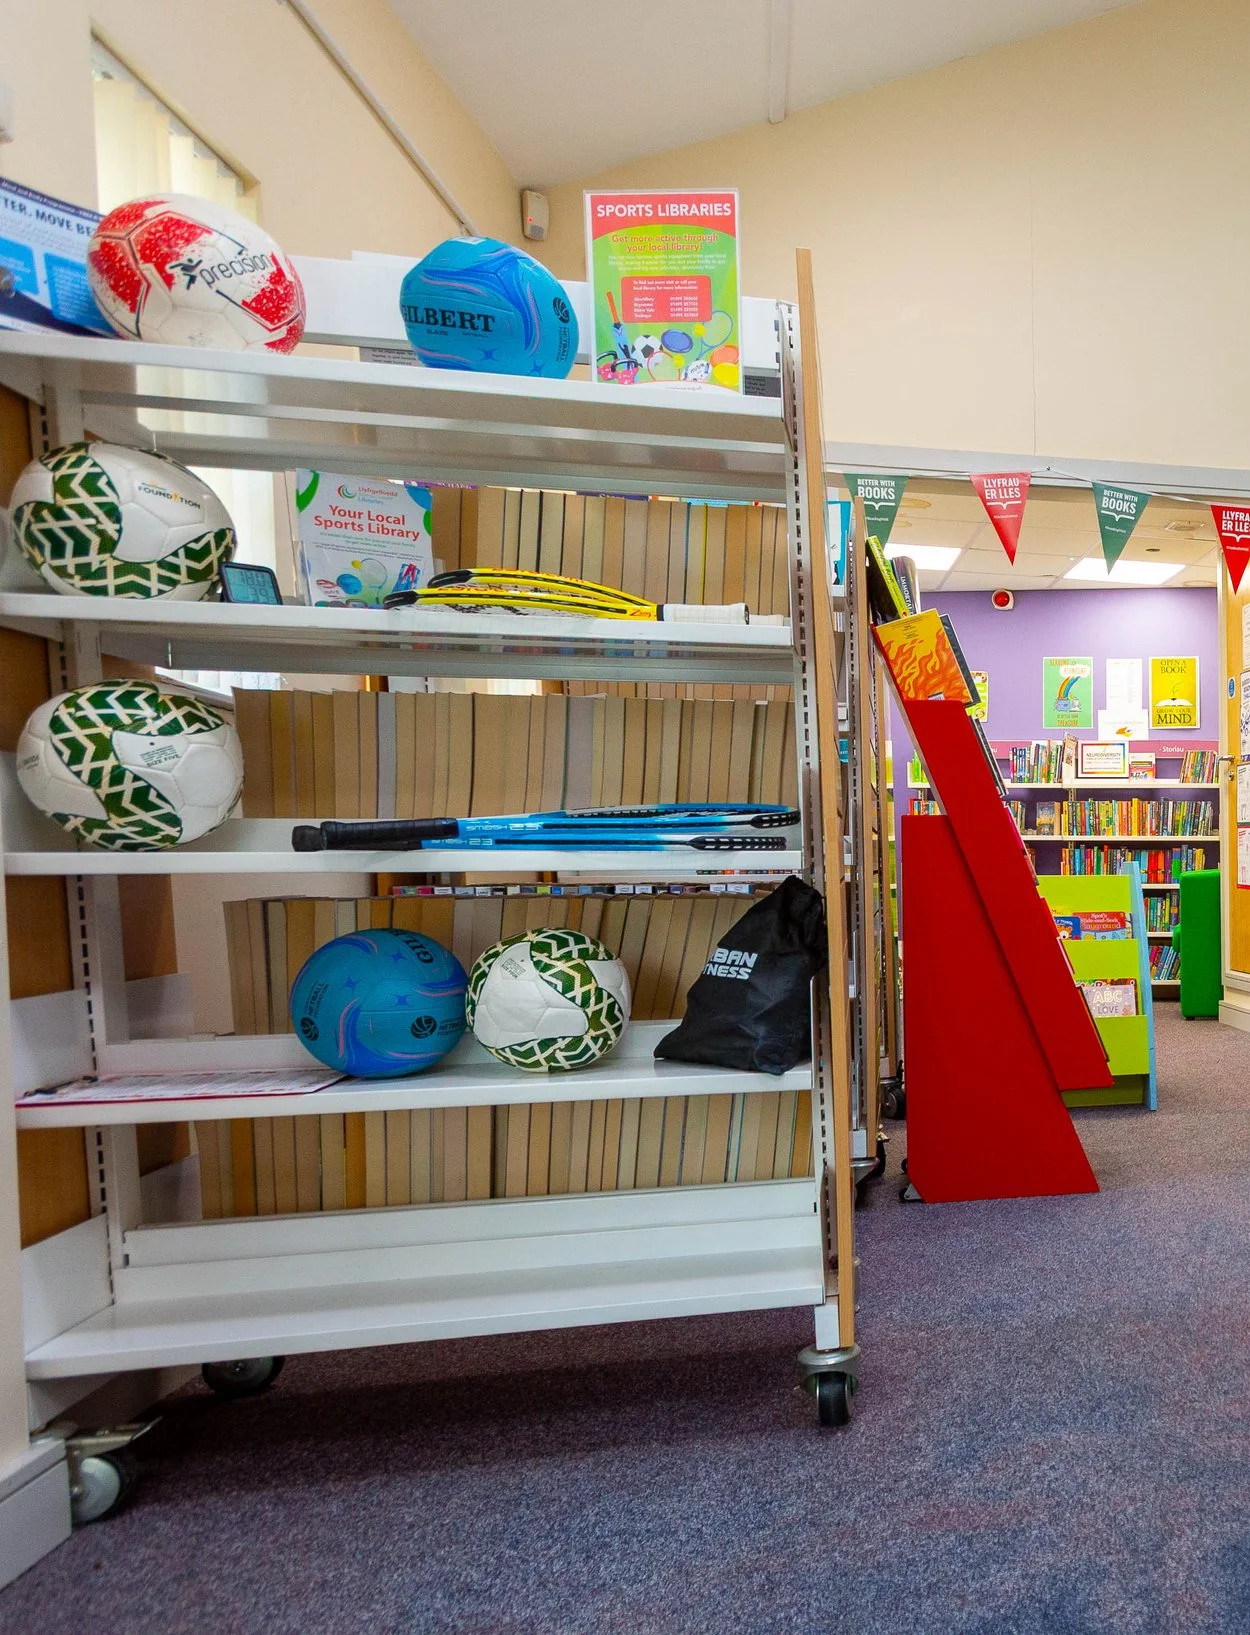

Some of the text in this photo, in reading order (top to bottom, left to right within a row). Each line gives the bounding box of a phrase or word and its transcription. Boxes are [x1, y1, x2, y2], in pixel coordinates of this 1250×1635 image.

[597, 203, 732, 217] SPORTS LIBRARIES
[36, 209, 73, 231] MOVE
[612, 235, 628, 243] Get
[656, 234, 681, 242] active
[684, 233, 719, 244] through
[627, 242, 703, 253] your local library!
[200, 252, 271, 285] precision
[401, 304, 495, 333] GILBERT
[857, 478, 895, 488] BETTER WITH
[983, 477, 1020, 489] LLYFRAU
[857, 486, 896, 500] BOOKS
[985, 488, 1021, 500] ER LLES
[1103, 489, 1138, 502] BETTER WITH
[1102, 496, 1136, 514] BOOKS
[329, 504, 405, 525] Your Local
[314, 515, 364, 532] Sports
[368, 523, 420, 542] Library
[1222, 521, 1233, 531] ER
[1157, 714, 1192, 725] MIND
[1162, 745, 1185, 753] Storiau
[146, 754, 181, 768] SIZE FIVE
[1093, 990, 1122, 1003] ABC
[1097, 1006, 1119, 1014] LOVE
